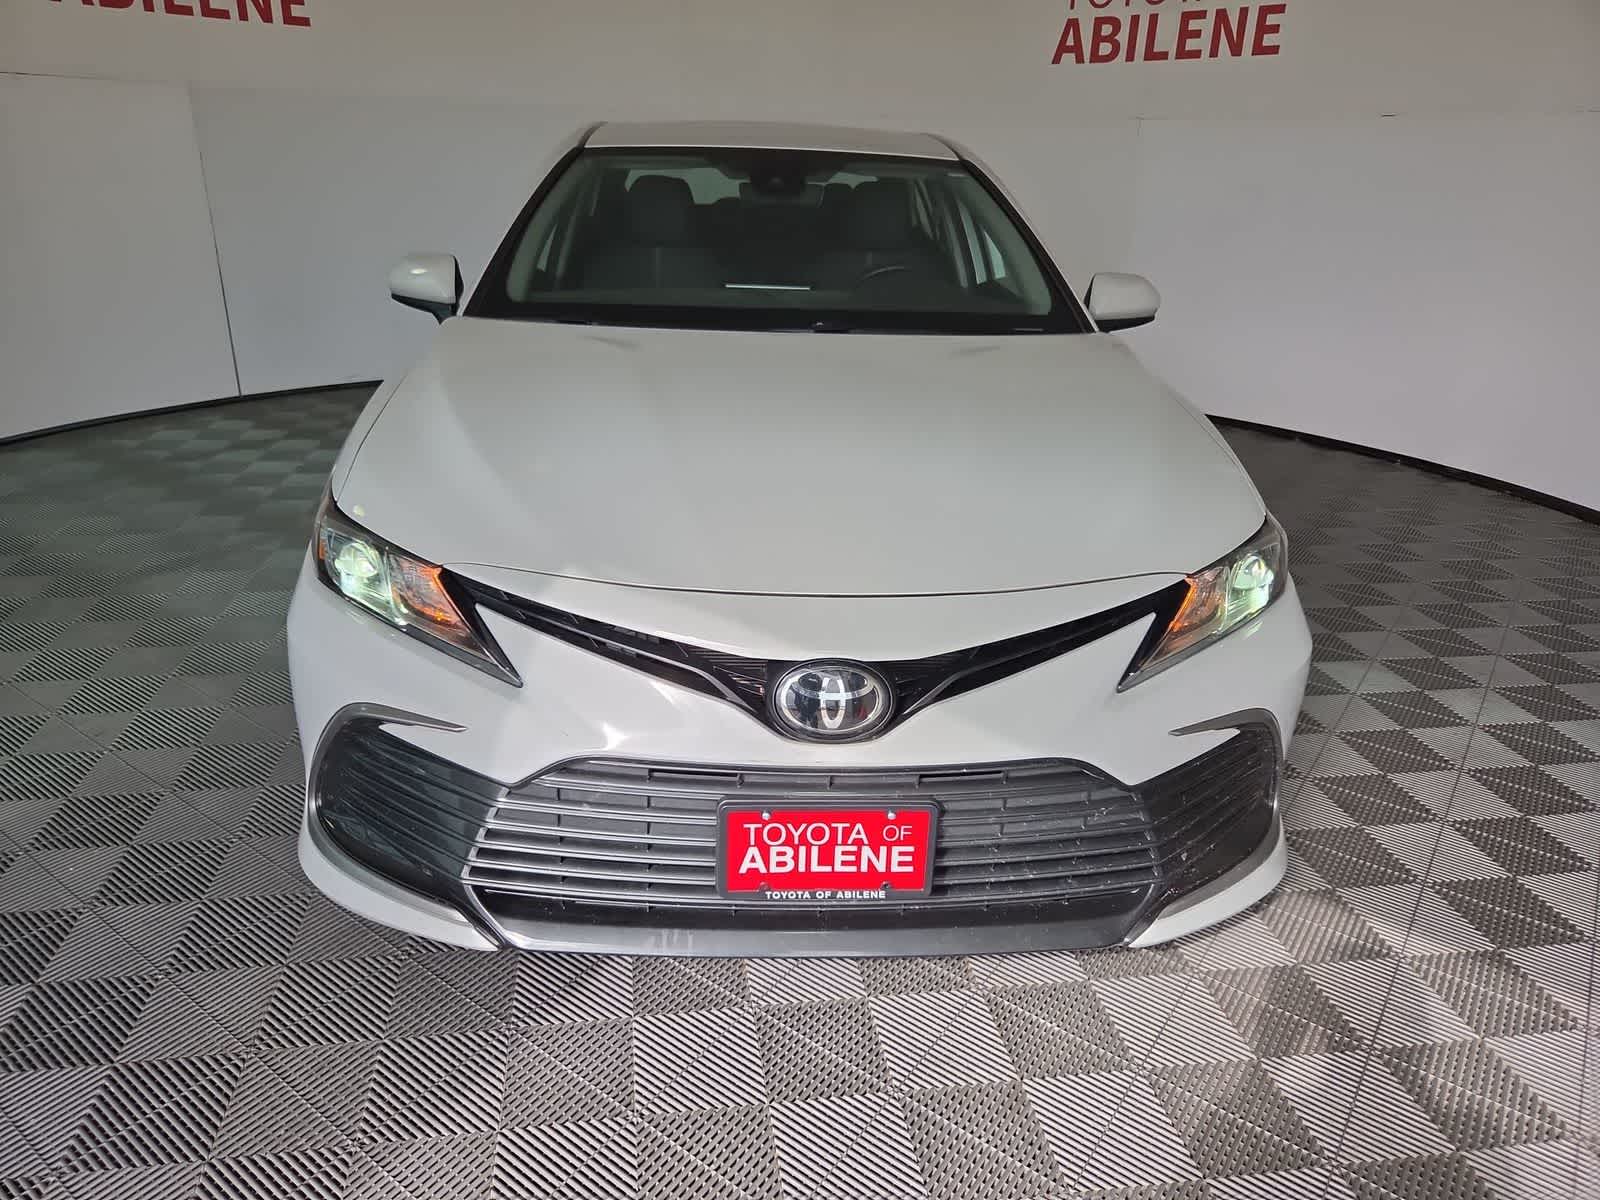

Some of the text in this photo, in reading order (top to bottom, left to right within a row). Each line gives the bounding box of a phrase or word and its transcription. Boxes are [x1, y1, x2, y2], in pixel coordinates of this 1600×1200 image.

[1051, 3, 1287, 65] ABILENE
[743, 822, 912, 845] TOYOTA OF
[739, 846, 915, 873] ABILENE
[765, 890, 886, 899] TOYOTA OF ABILENE
